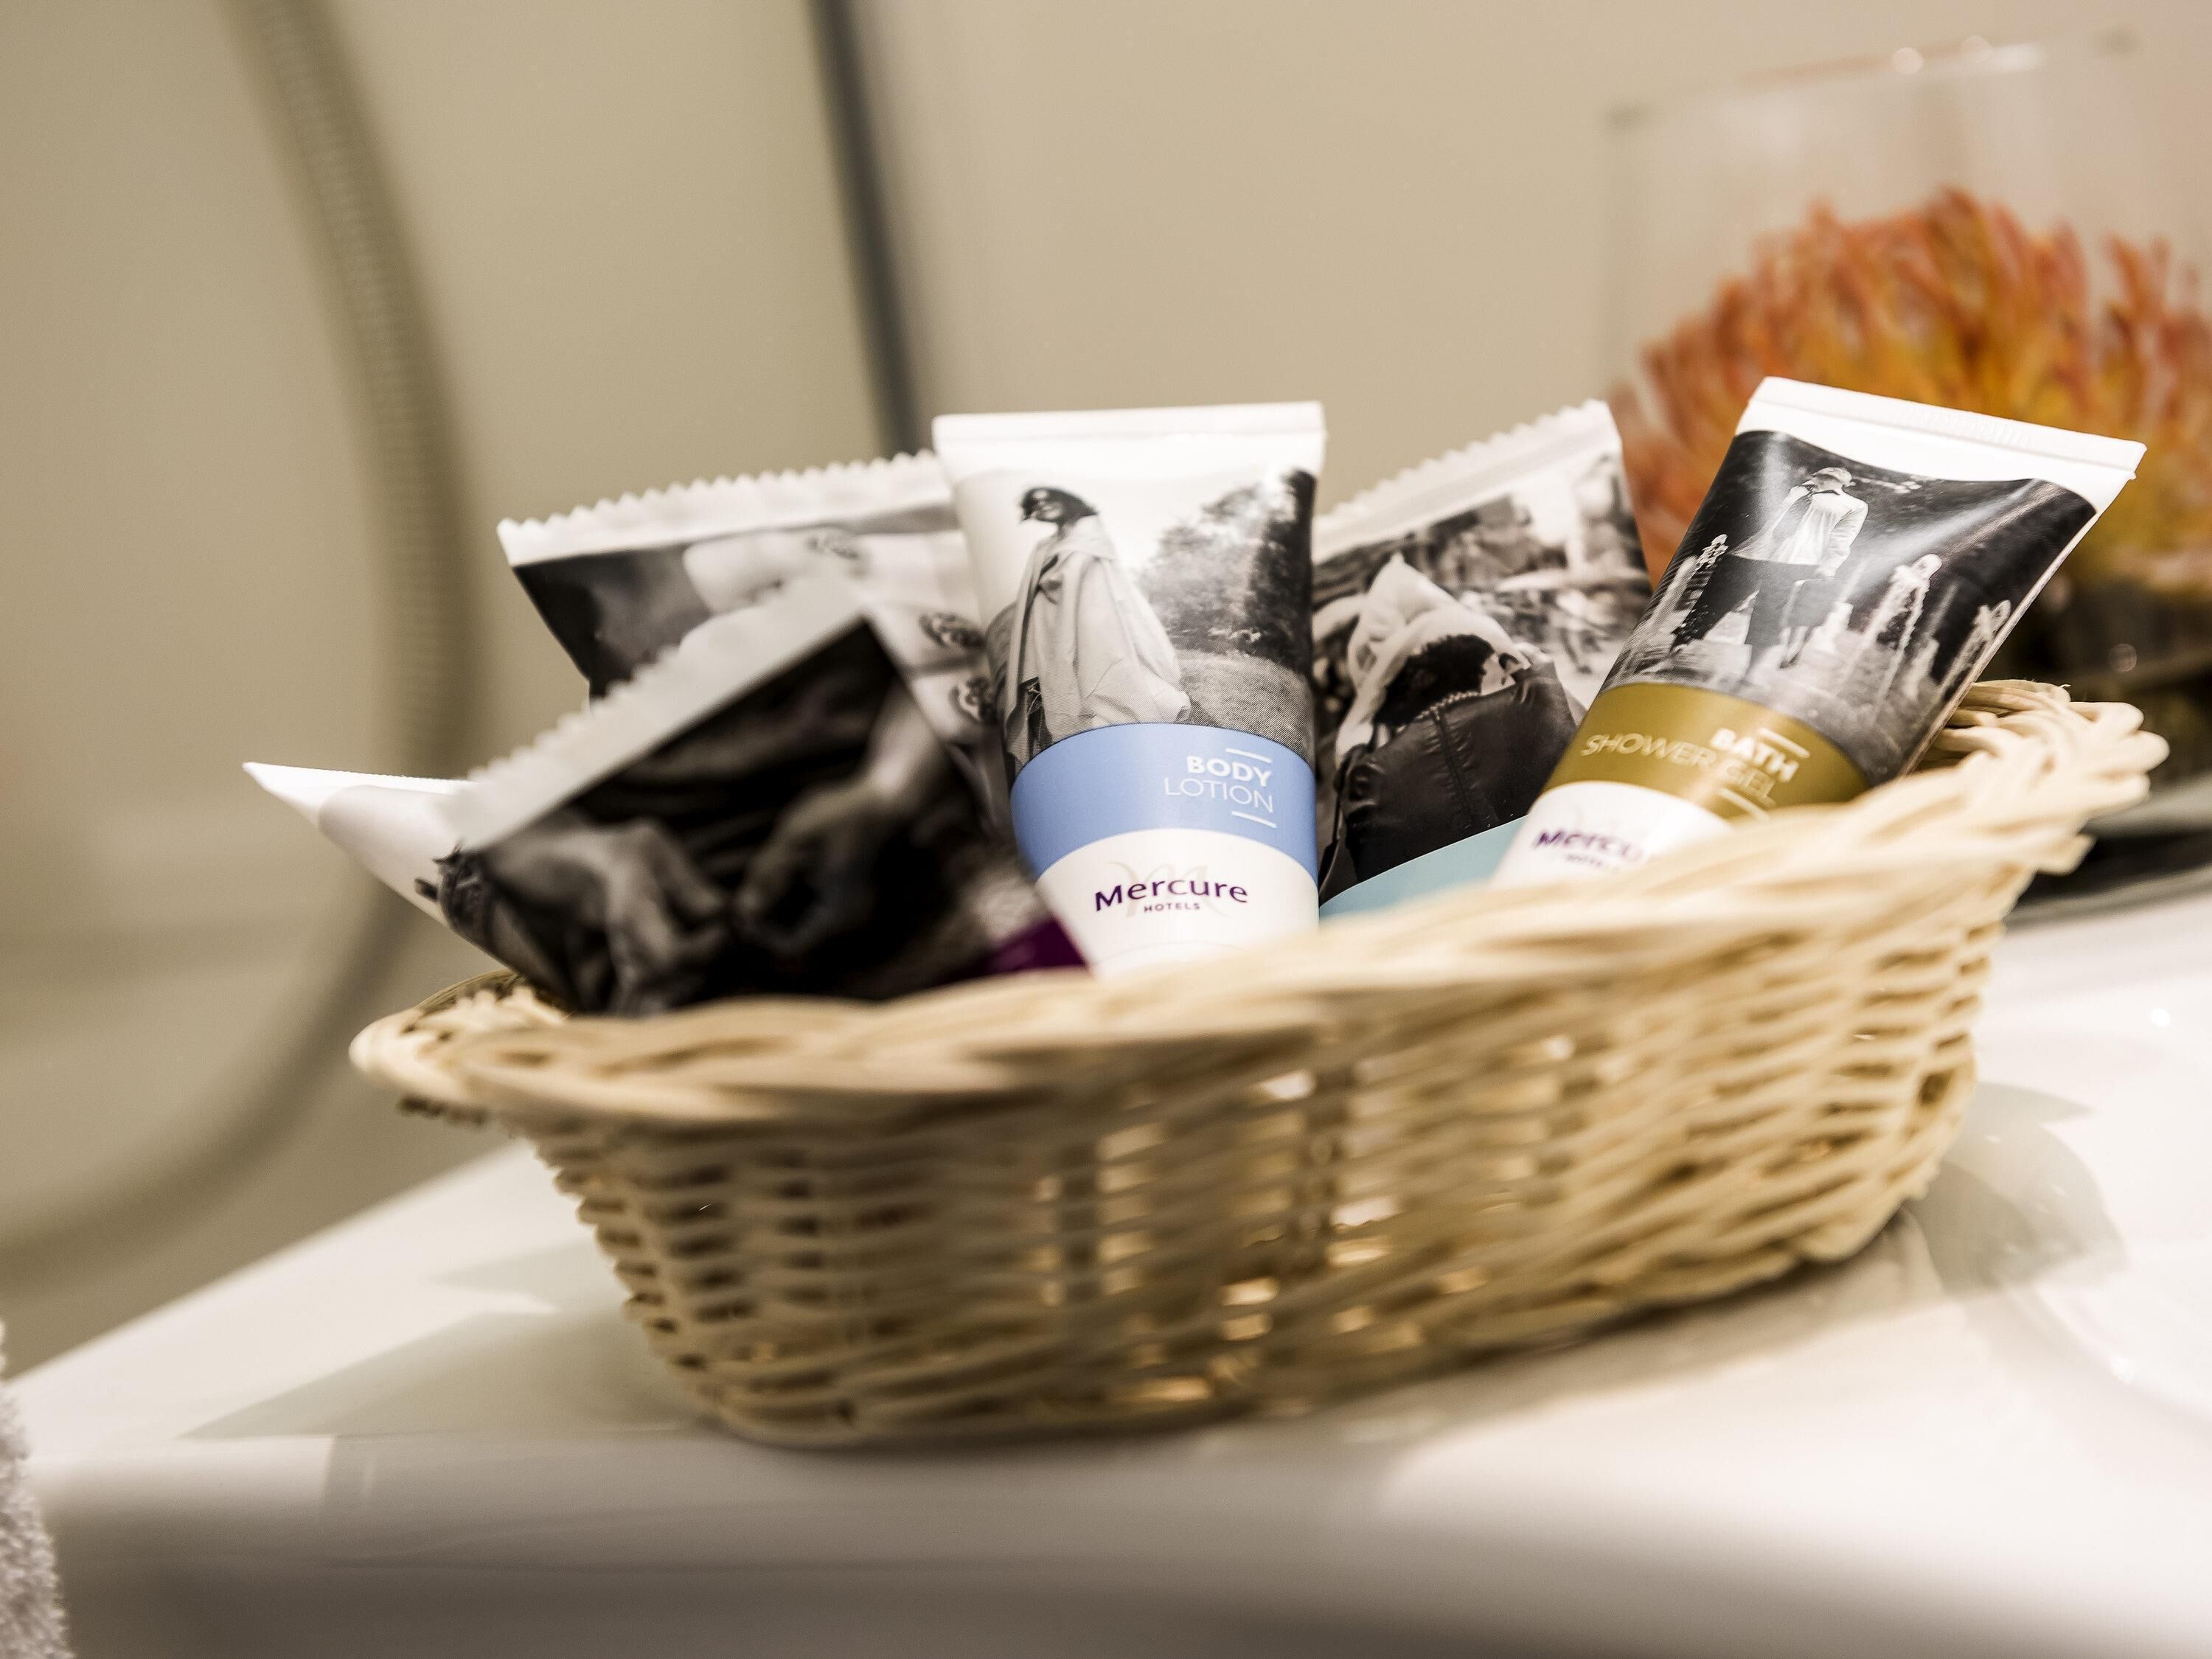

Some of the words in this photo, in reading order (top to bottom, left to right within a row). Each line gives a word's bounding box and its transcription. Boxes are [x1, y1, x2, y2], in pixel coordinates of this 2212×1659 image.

[1186, 755, 1272, 787] BODY
[1580, 733, 1717, 768] SHOWER
[1722, 758, 1777, 807] GEL
[1710, 728, 1799, 783] BATH
[1164, 777, 1273, 813] LOTION
[1533, 830, 1644, 862] Mercu
[1095, 880, 1248, 911] Mercure
[1144, 902, 1200, 913] HOTELS
